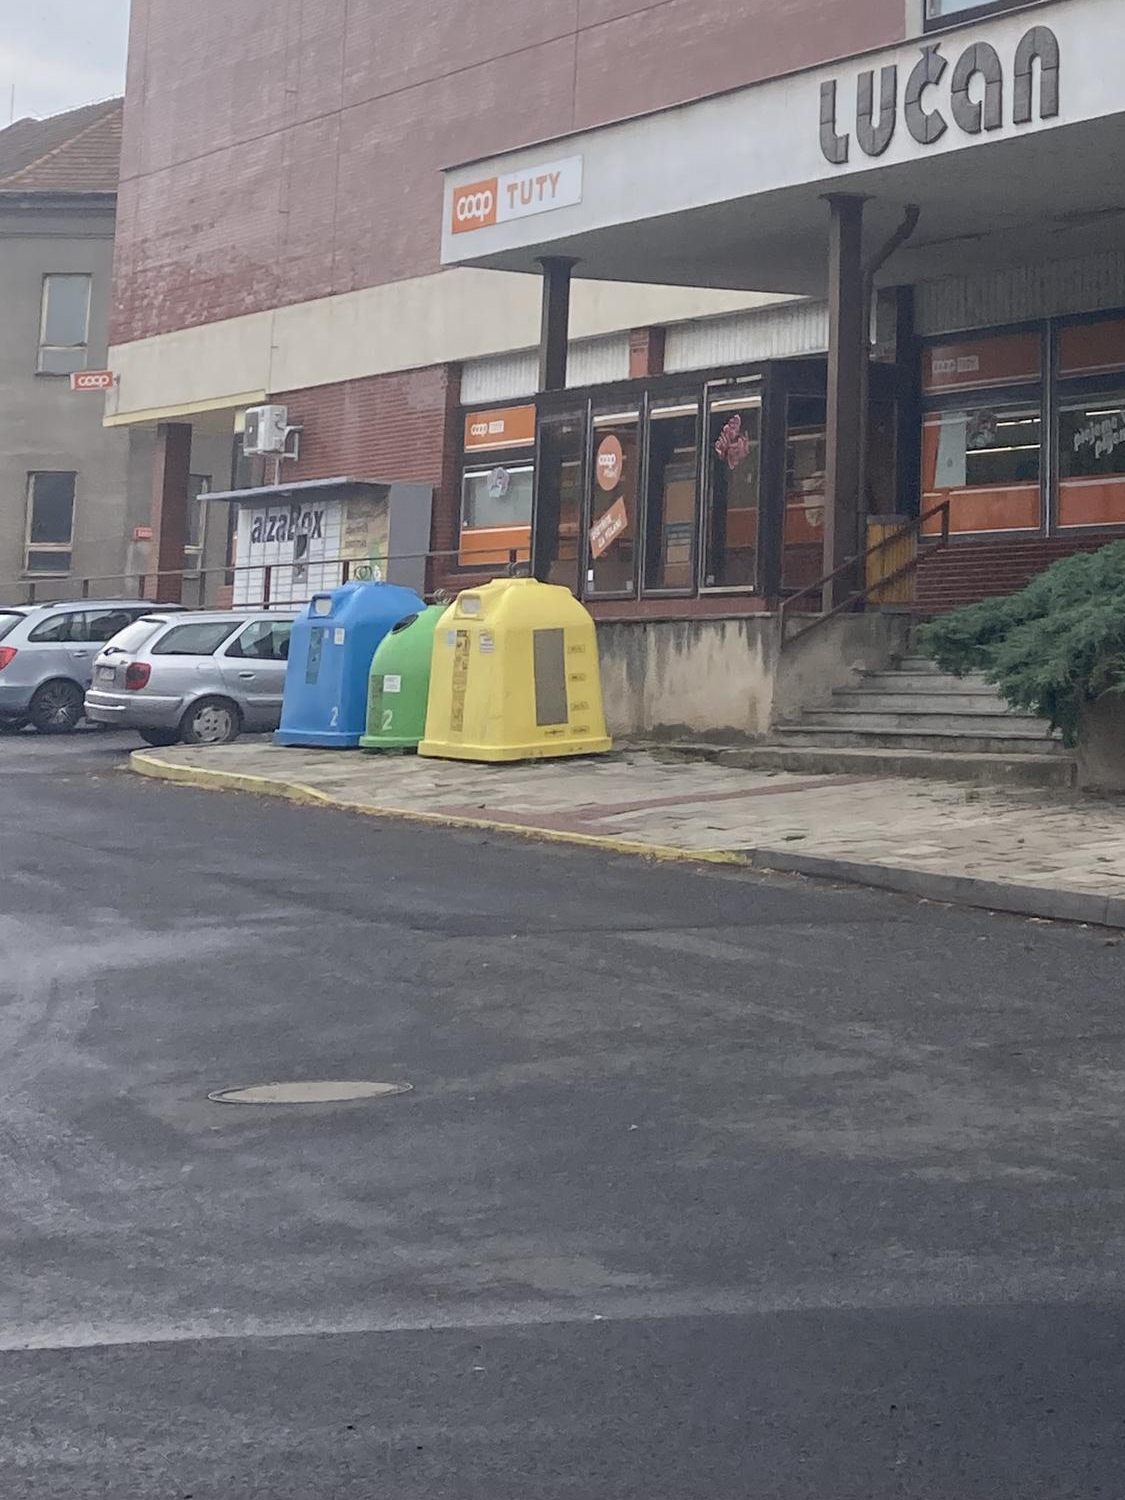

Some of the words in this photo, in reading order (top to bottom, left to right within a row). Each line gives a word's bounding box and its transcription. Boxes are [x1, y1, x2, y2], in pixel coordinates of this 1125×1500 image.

[456, 189, 493, 222] coop
[506, 171, 562, 210] TUTY
[77, 374, 110, 388] coop
[329, 705, 339, 728] 2
[381, 708, 394, 732] 2
